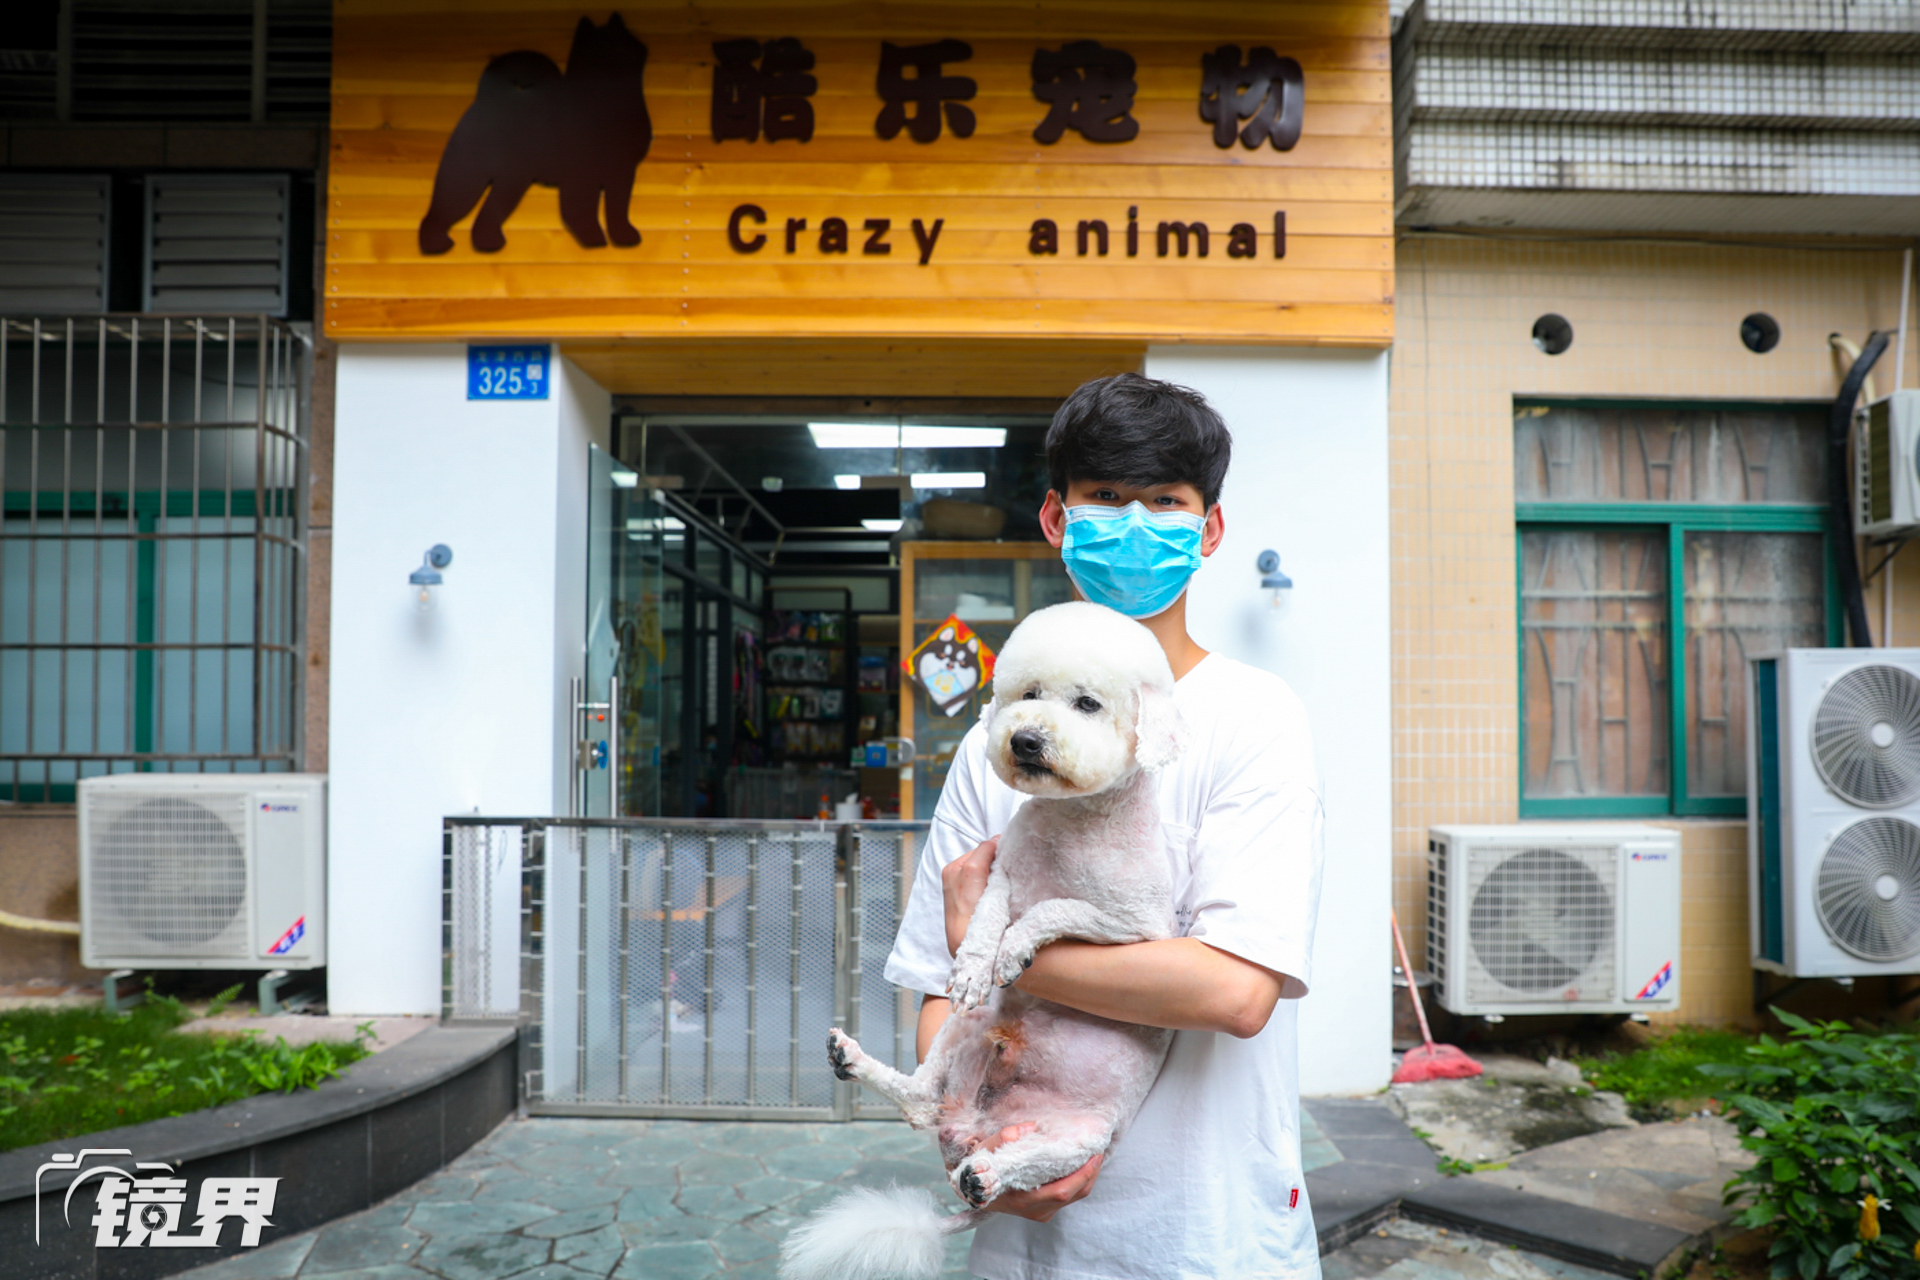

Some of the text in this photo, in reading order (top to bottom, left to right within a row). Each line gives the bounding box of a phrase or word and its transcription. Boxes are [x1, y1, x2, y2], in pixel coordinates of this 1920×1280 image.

[712, 37, 1304, 152] 酷乐宠物
[727, 203, 1287, 266] Crazy animal
